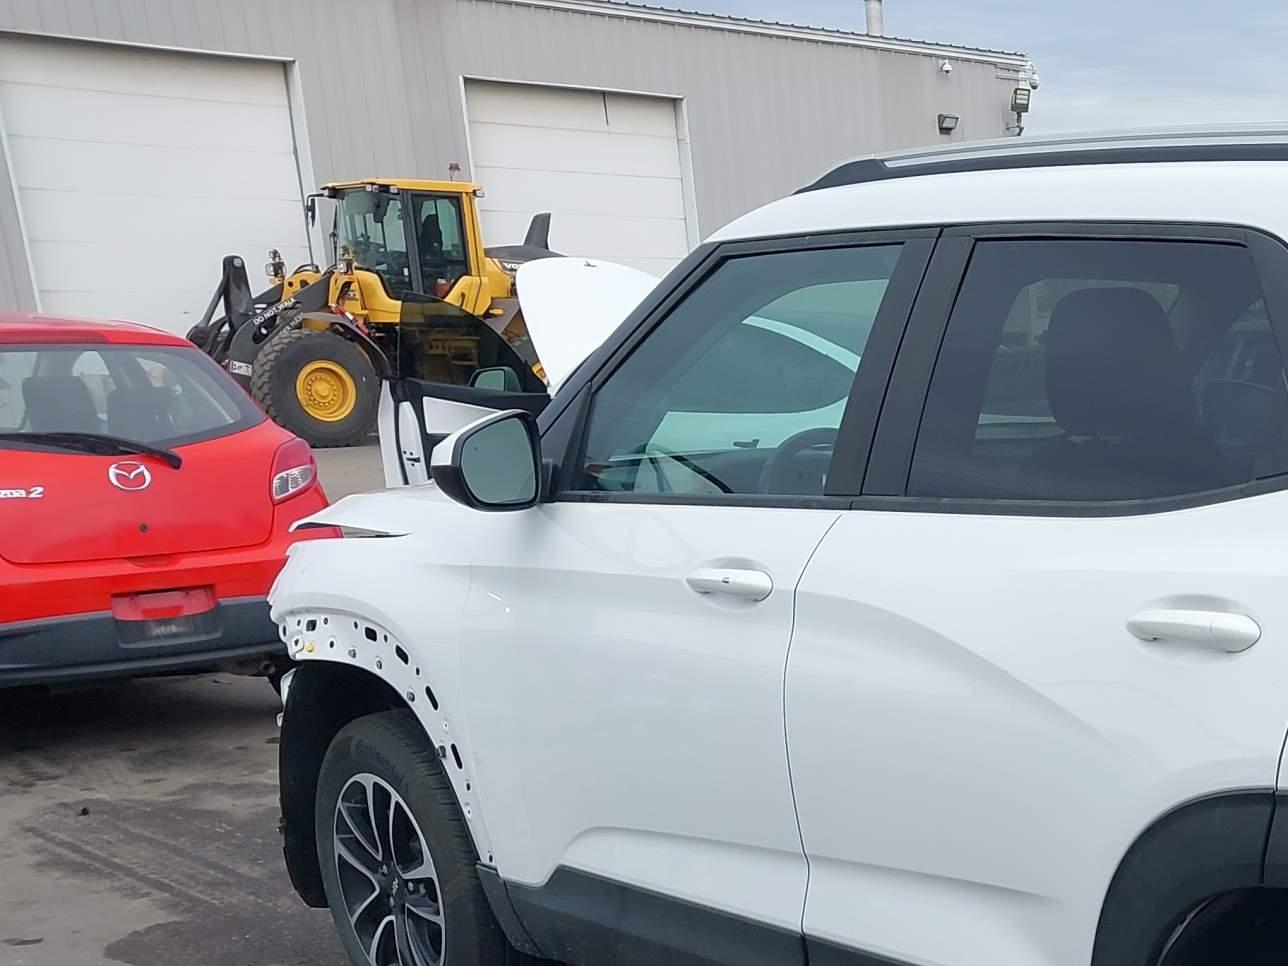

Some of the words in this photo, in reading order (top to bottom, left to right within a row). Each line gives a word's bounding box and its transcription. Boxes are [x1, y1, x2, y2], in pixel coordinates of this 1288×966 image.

[253, 316, 264, 325] DO
[264, 306, 278, 320] NOT
[28, 486, 44, 498] 2
